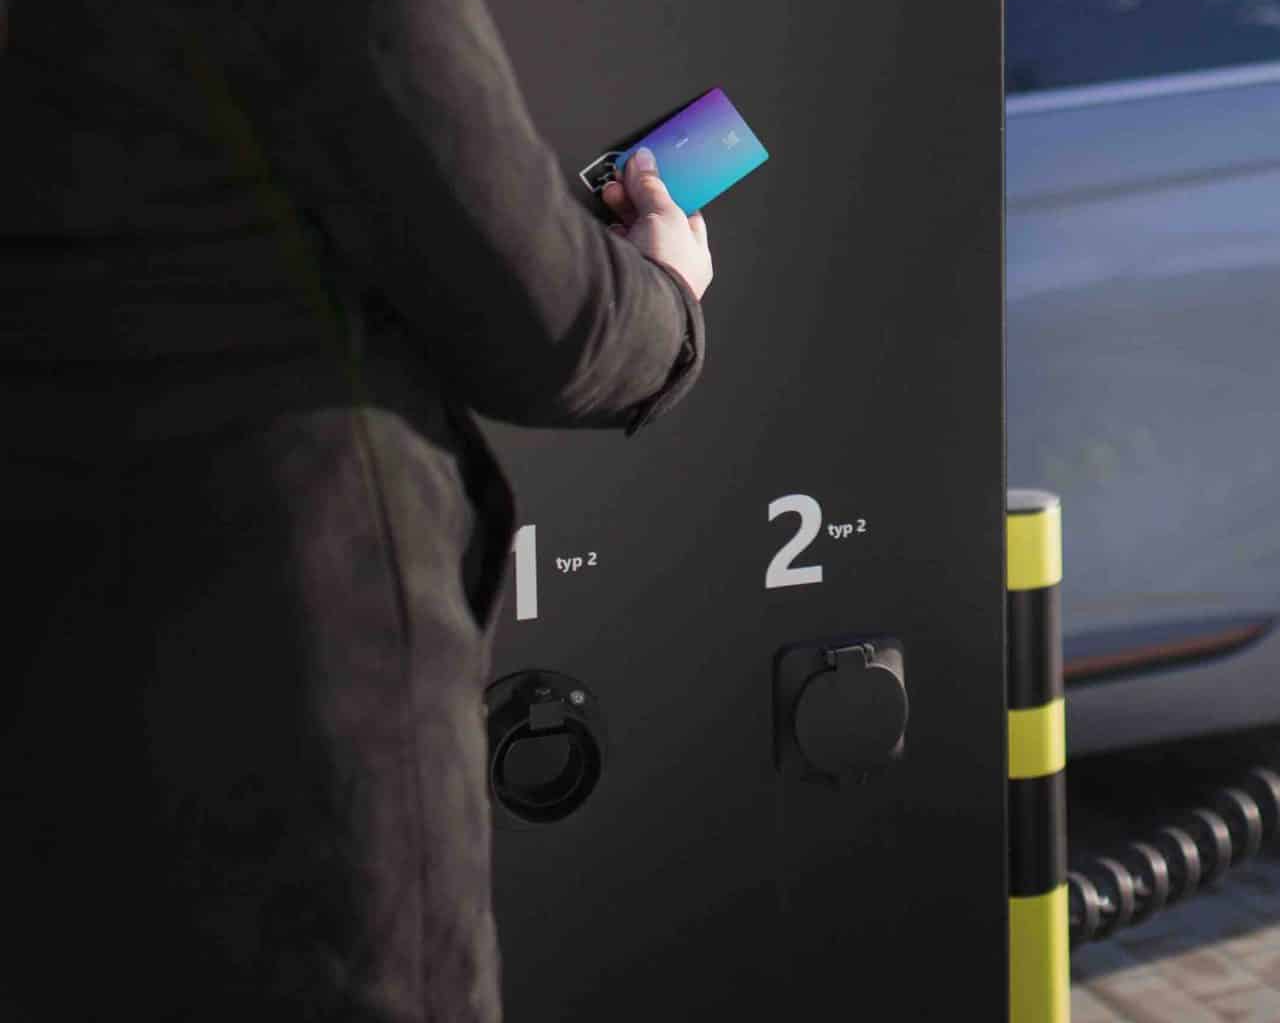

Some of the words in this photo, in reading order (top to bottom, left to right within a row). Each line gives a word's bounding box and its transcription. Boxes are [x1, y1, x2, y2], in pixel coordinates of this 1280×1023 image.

[765, 493, 824, 589] 2
[827, 523, 854, 539] typ
[856, 519, 867, 533] 2
[512, 524, 538, 621] 1
[555, 555, 583, 574] typ
[587, 552, 598, 566] 2
